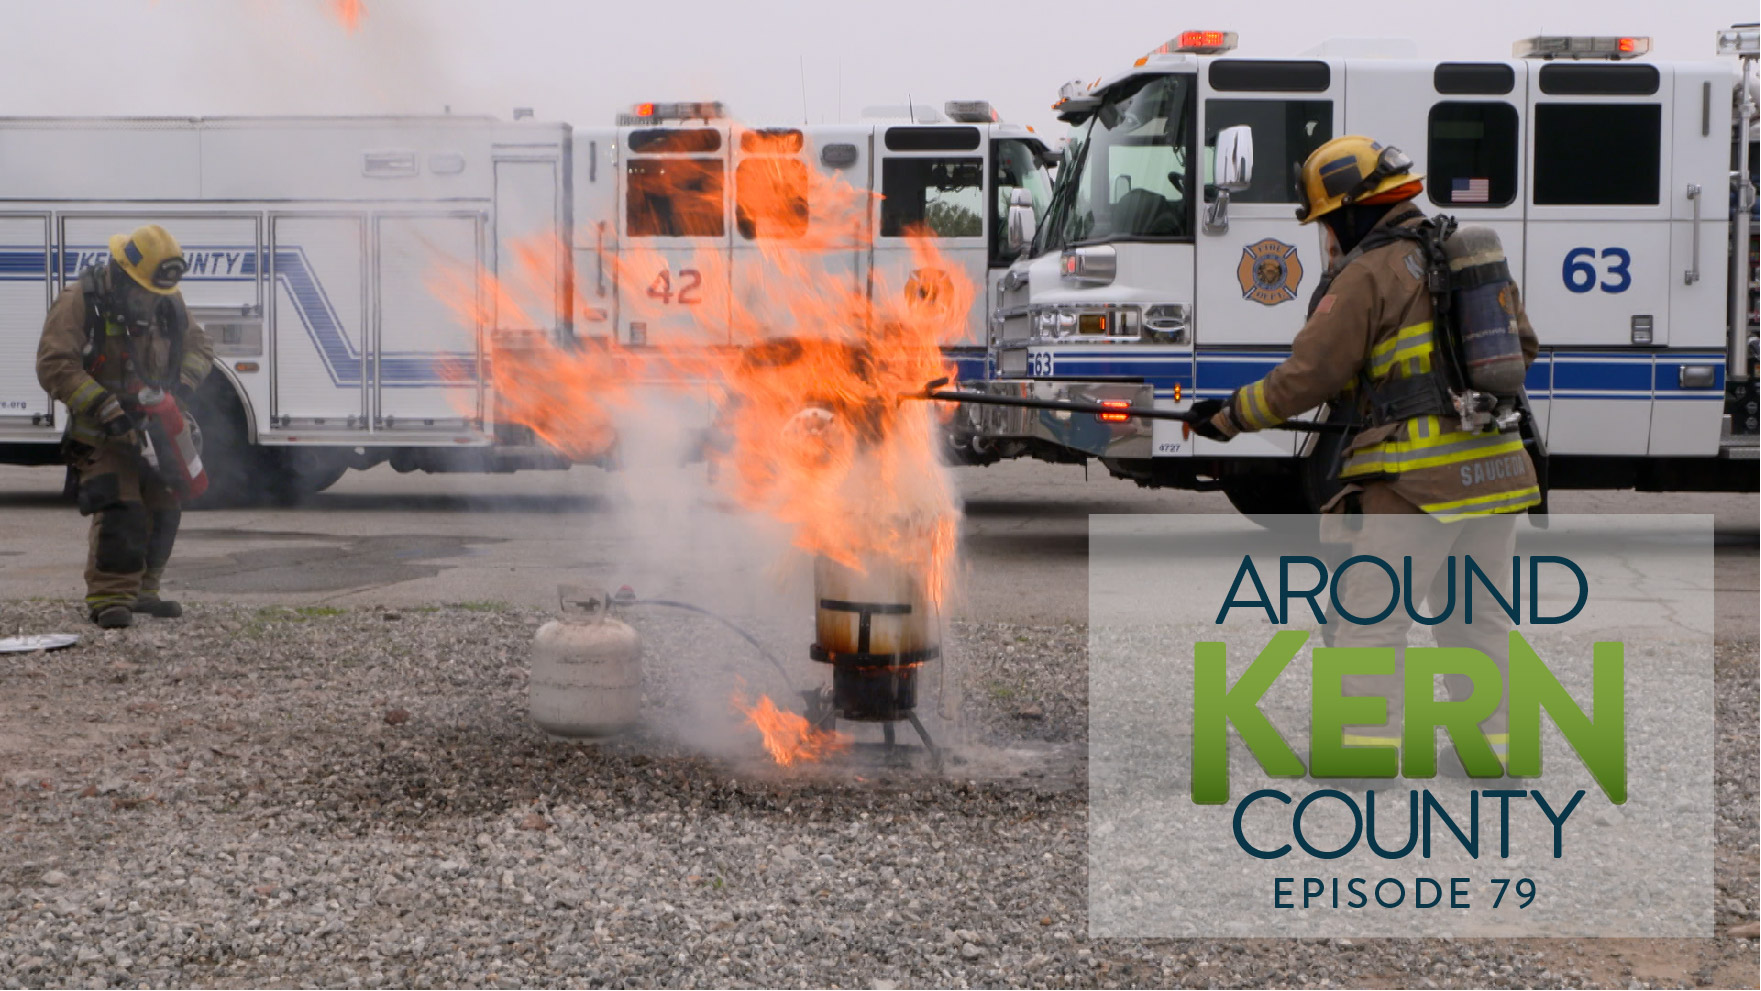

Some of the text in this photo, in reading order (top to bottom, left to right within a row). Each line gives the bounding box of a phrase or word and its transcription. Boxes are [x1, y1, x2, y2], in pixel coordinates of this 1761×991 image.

[1562, 247, 1632, 293] 63
[646, 269, 703, 304] 42
[1034, 353, 1052, 375] 63
[1159, 443, 1181, 453] 4727
[1460, 455, 1526, 486] SAUCEDA
